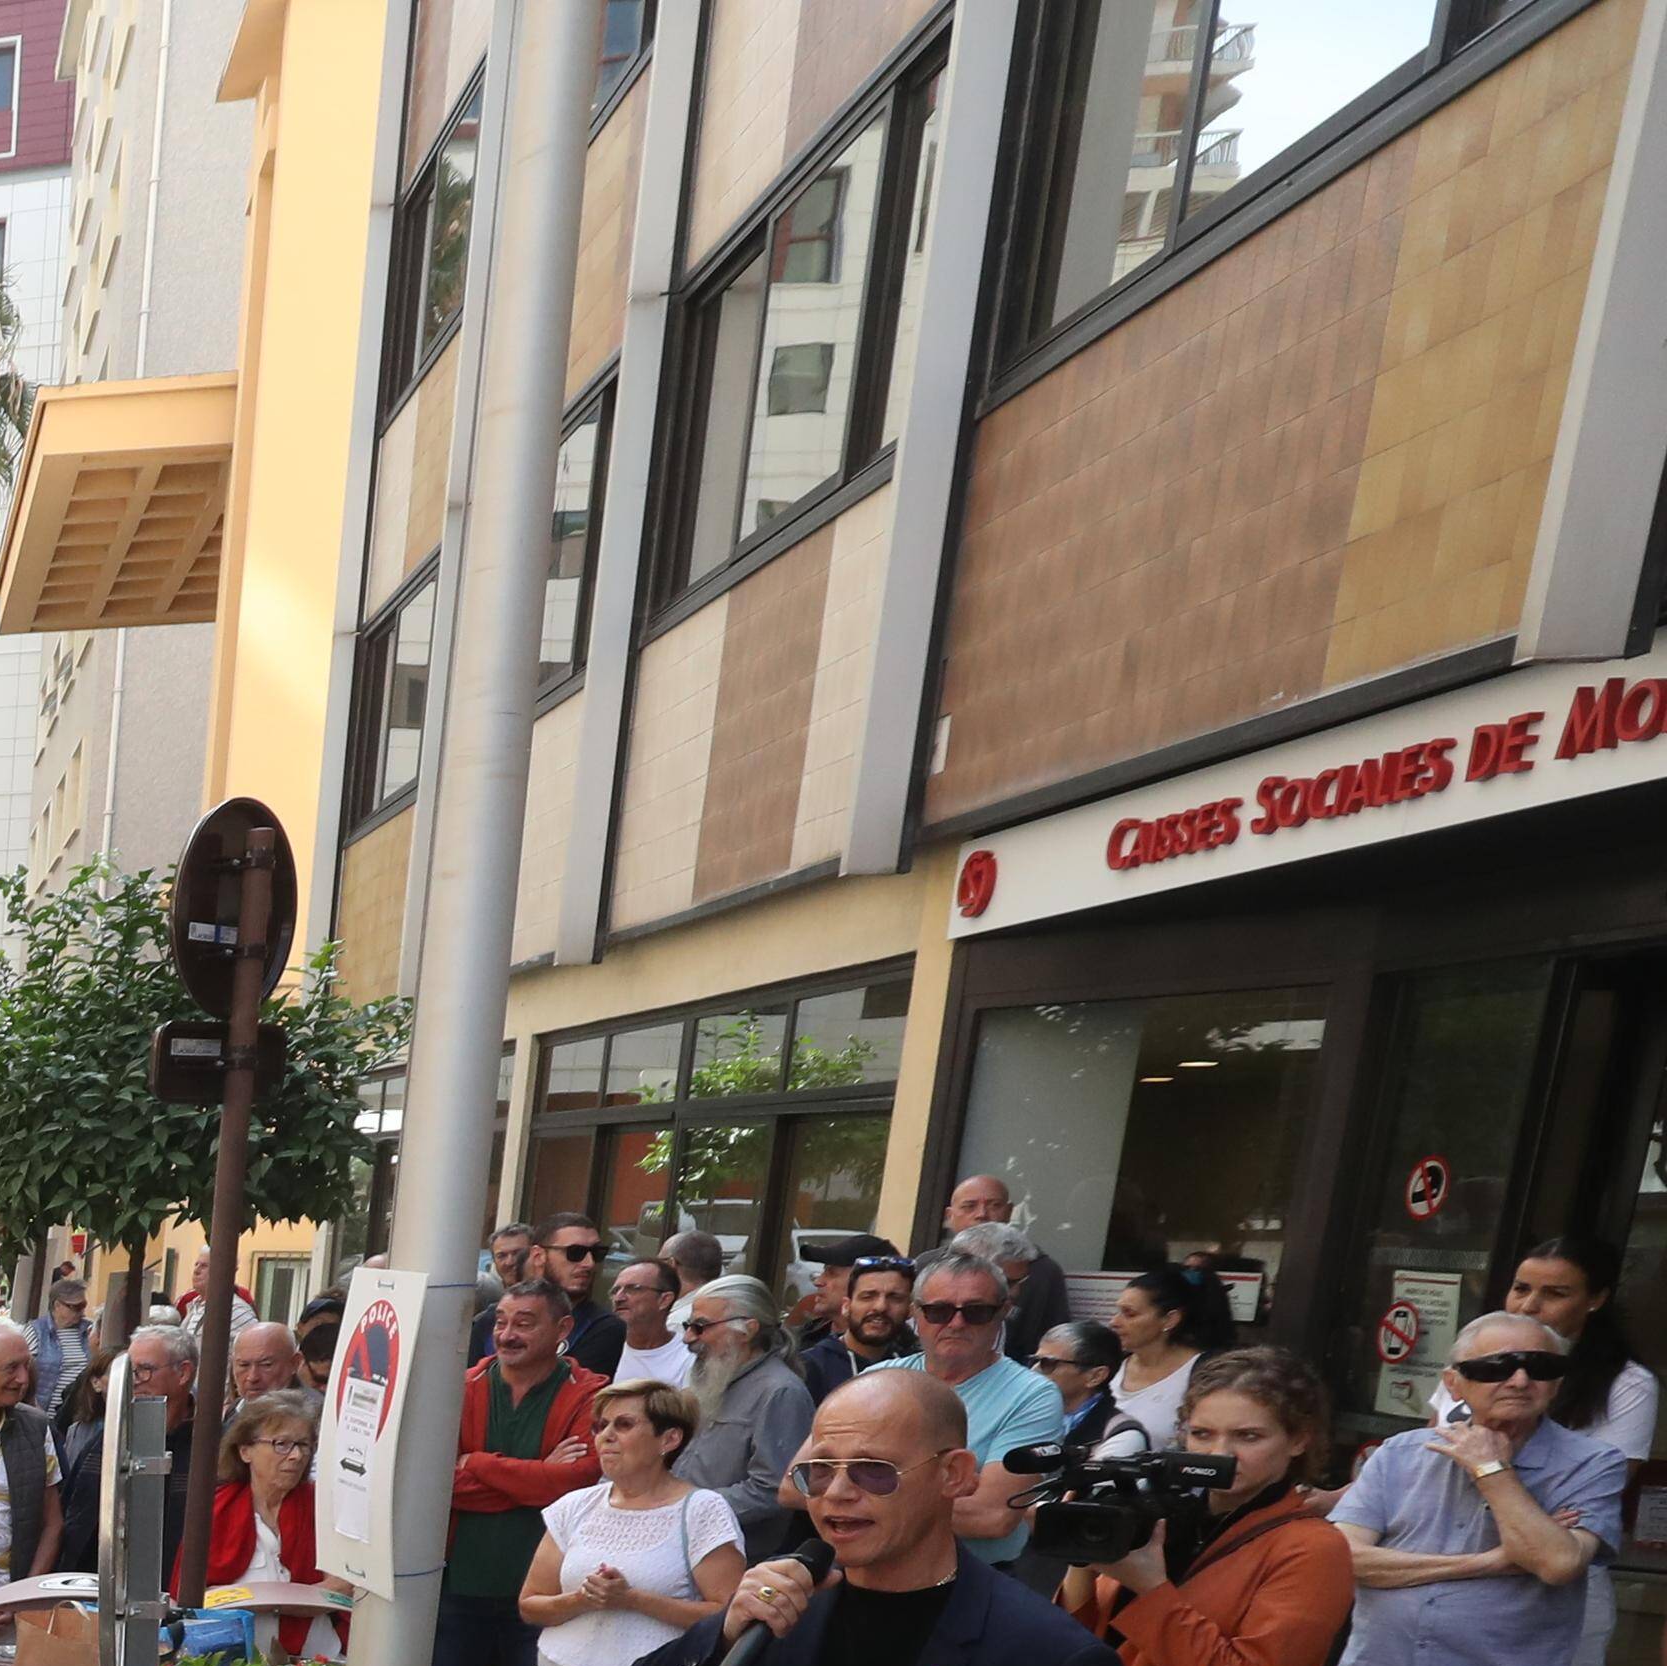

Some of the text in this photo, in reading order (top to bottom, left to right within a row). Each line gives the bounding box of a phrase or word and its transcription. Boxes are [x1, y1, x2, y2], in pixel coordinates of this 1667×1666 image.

[1107, 676, 1667, 872] CAISSES SOCIALES DE MO
[360, 1302, 399, 1340] POLICE
